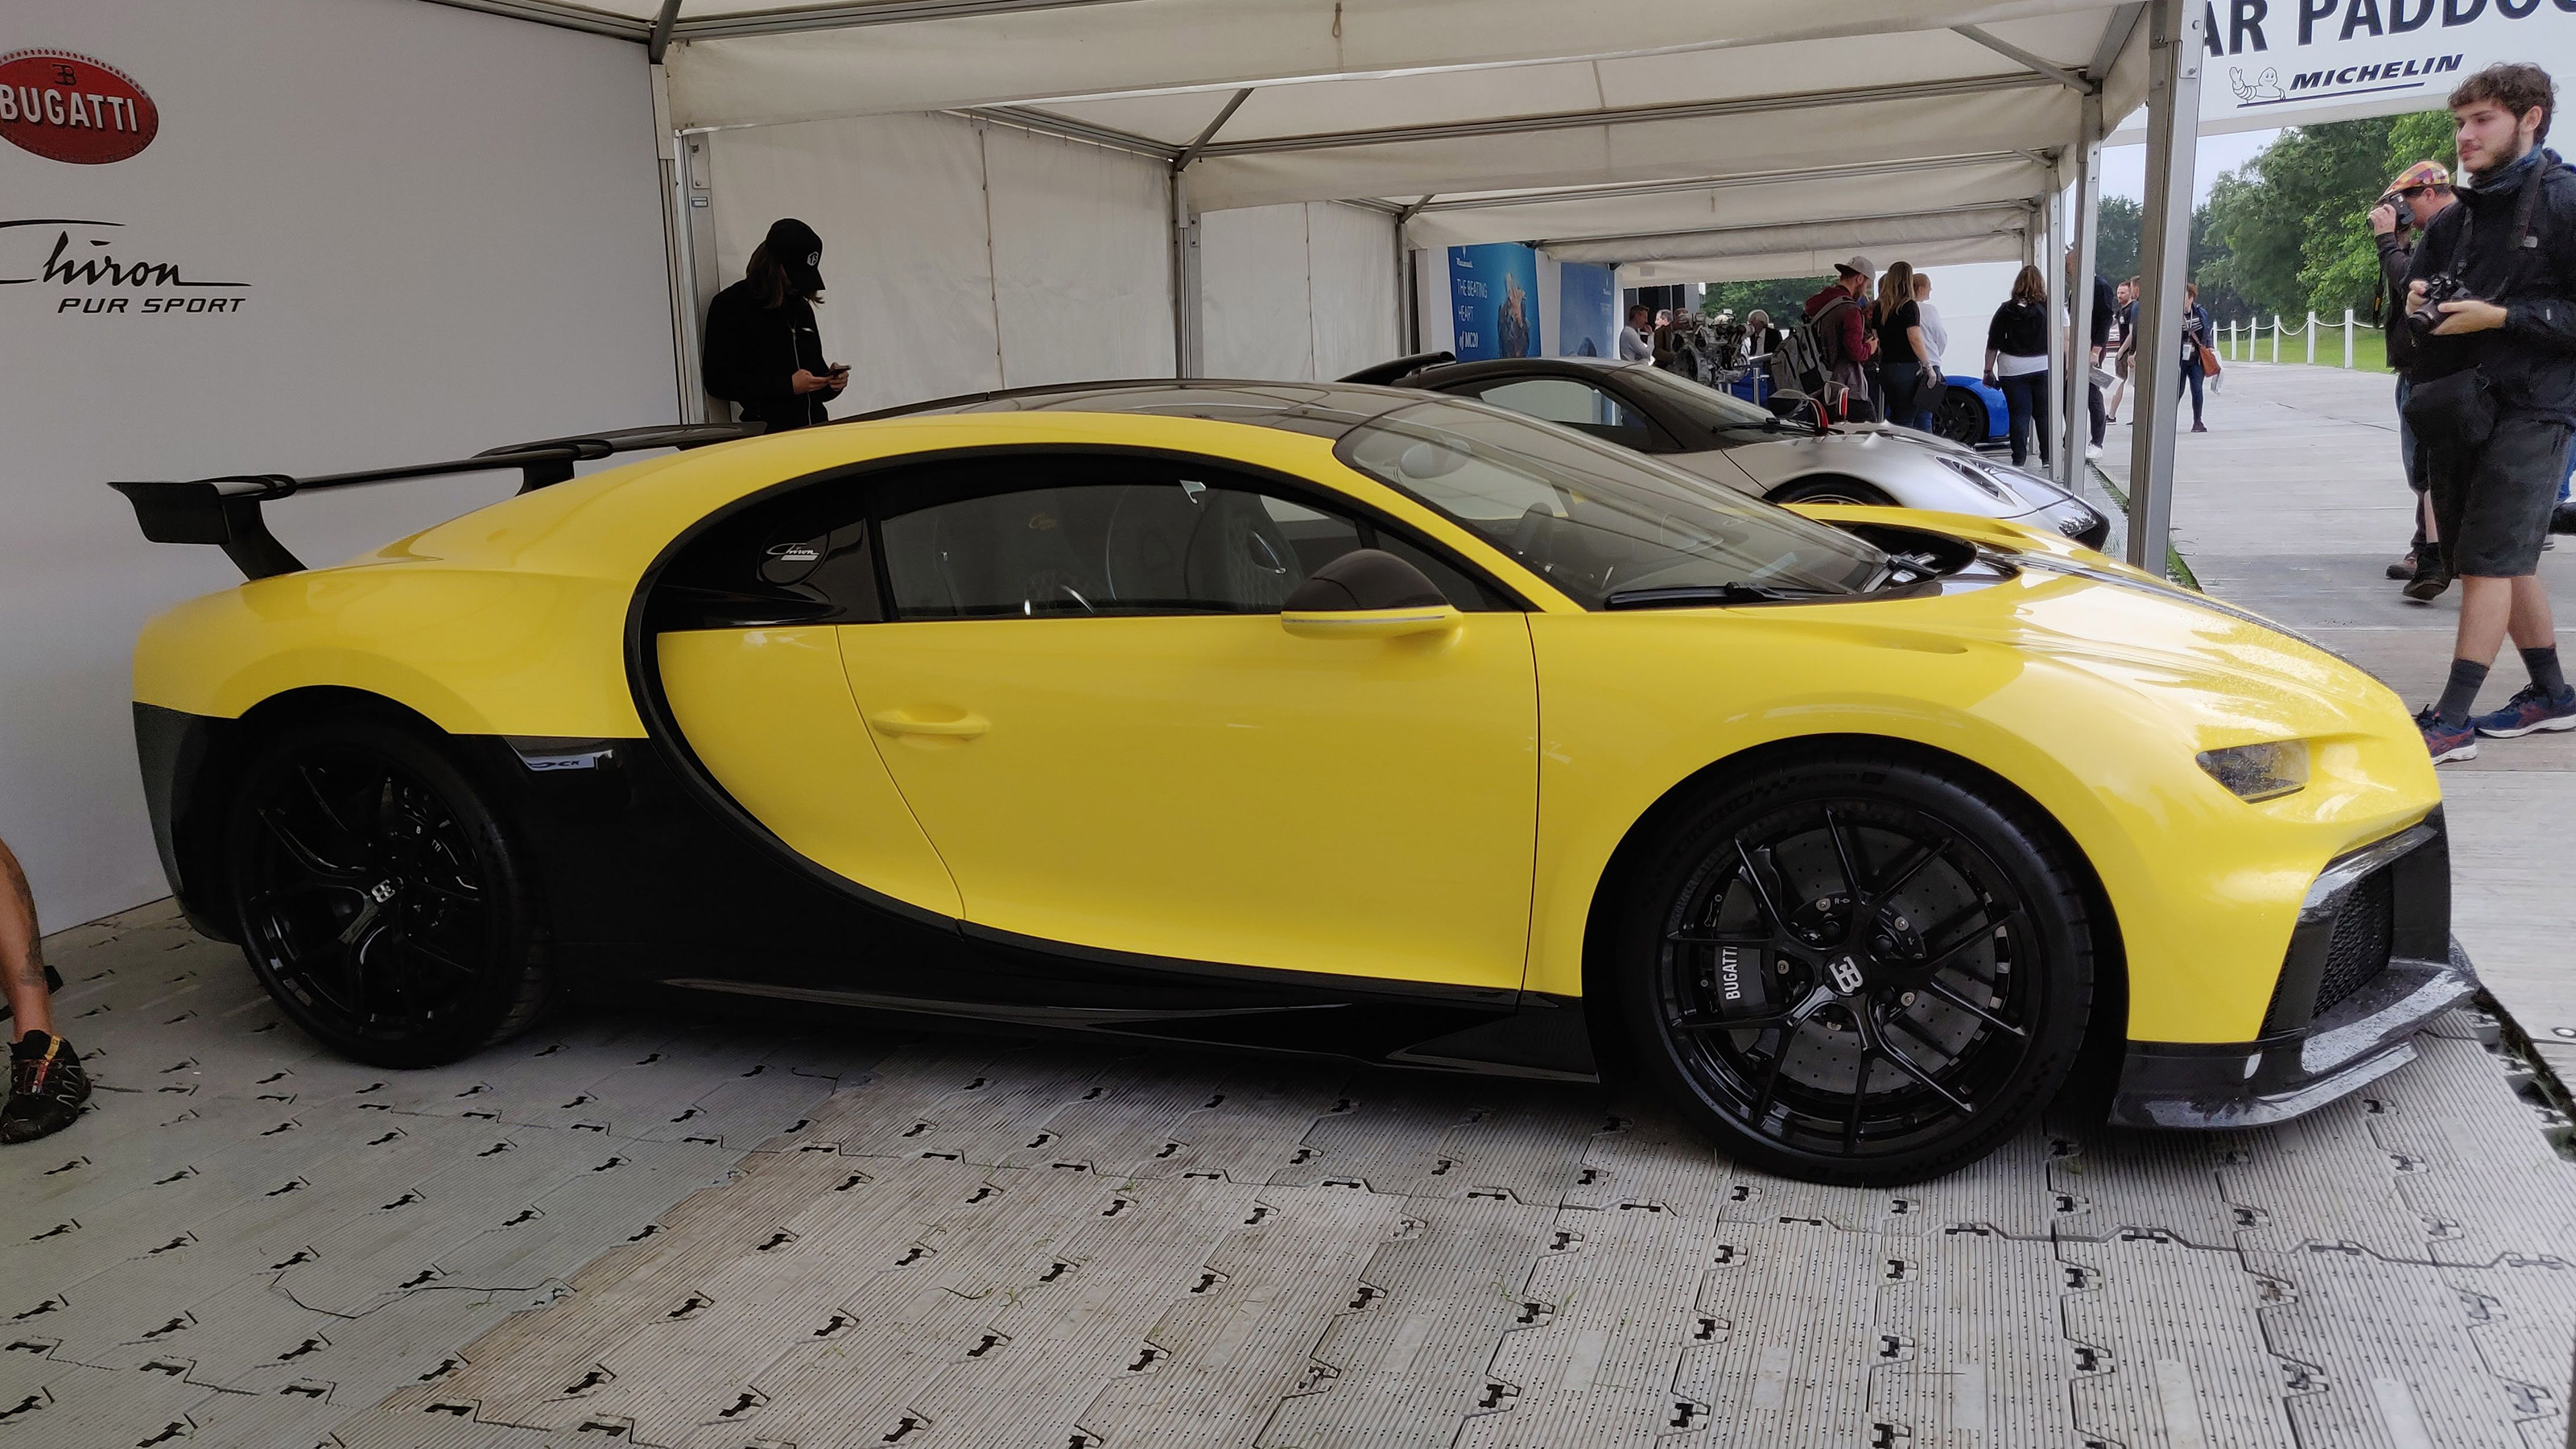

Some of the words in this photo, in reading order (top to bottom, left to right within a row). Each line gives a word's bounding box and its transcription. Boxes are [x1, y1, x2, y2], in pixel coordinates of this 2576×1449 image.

[2289, 54, 2463, 91] MICHELIN
[0, 84, 138, 132] BUGATTI
[1456, 279, 1467, 297] THE
[1468, 280, 1488, 299] BEATING
[57, 298, 129, 314] PUR
[140, 298, 246, 314] SPORT
[1458, 305, 1474, 322] HEART
[1464, 332, 1479, 349] MC20
[1722, 946, 1741, 1000] BUGATTI
